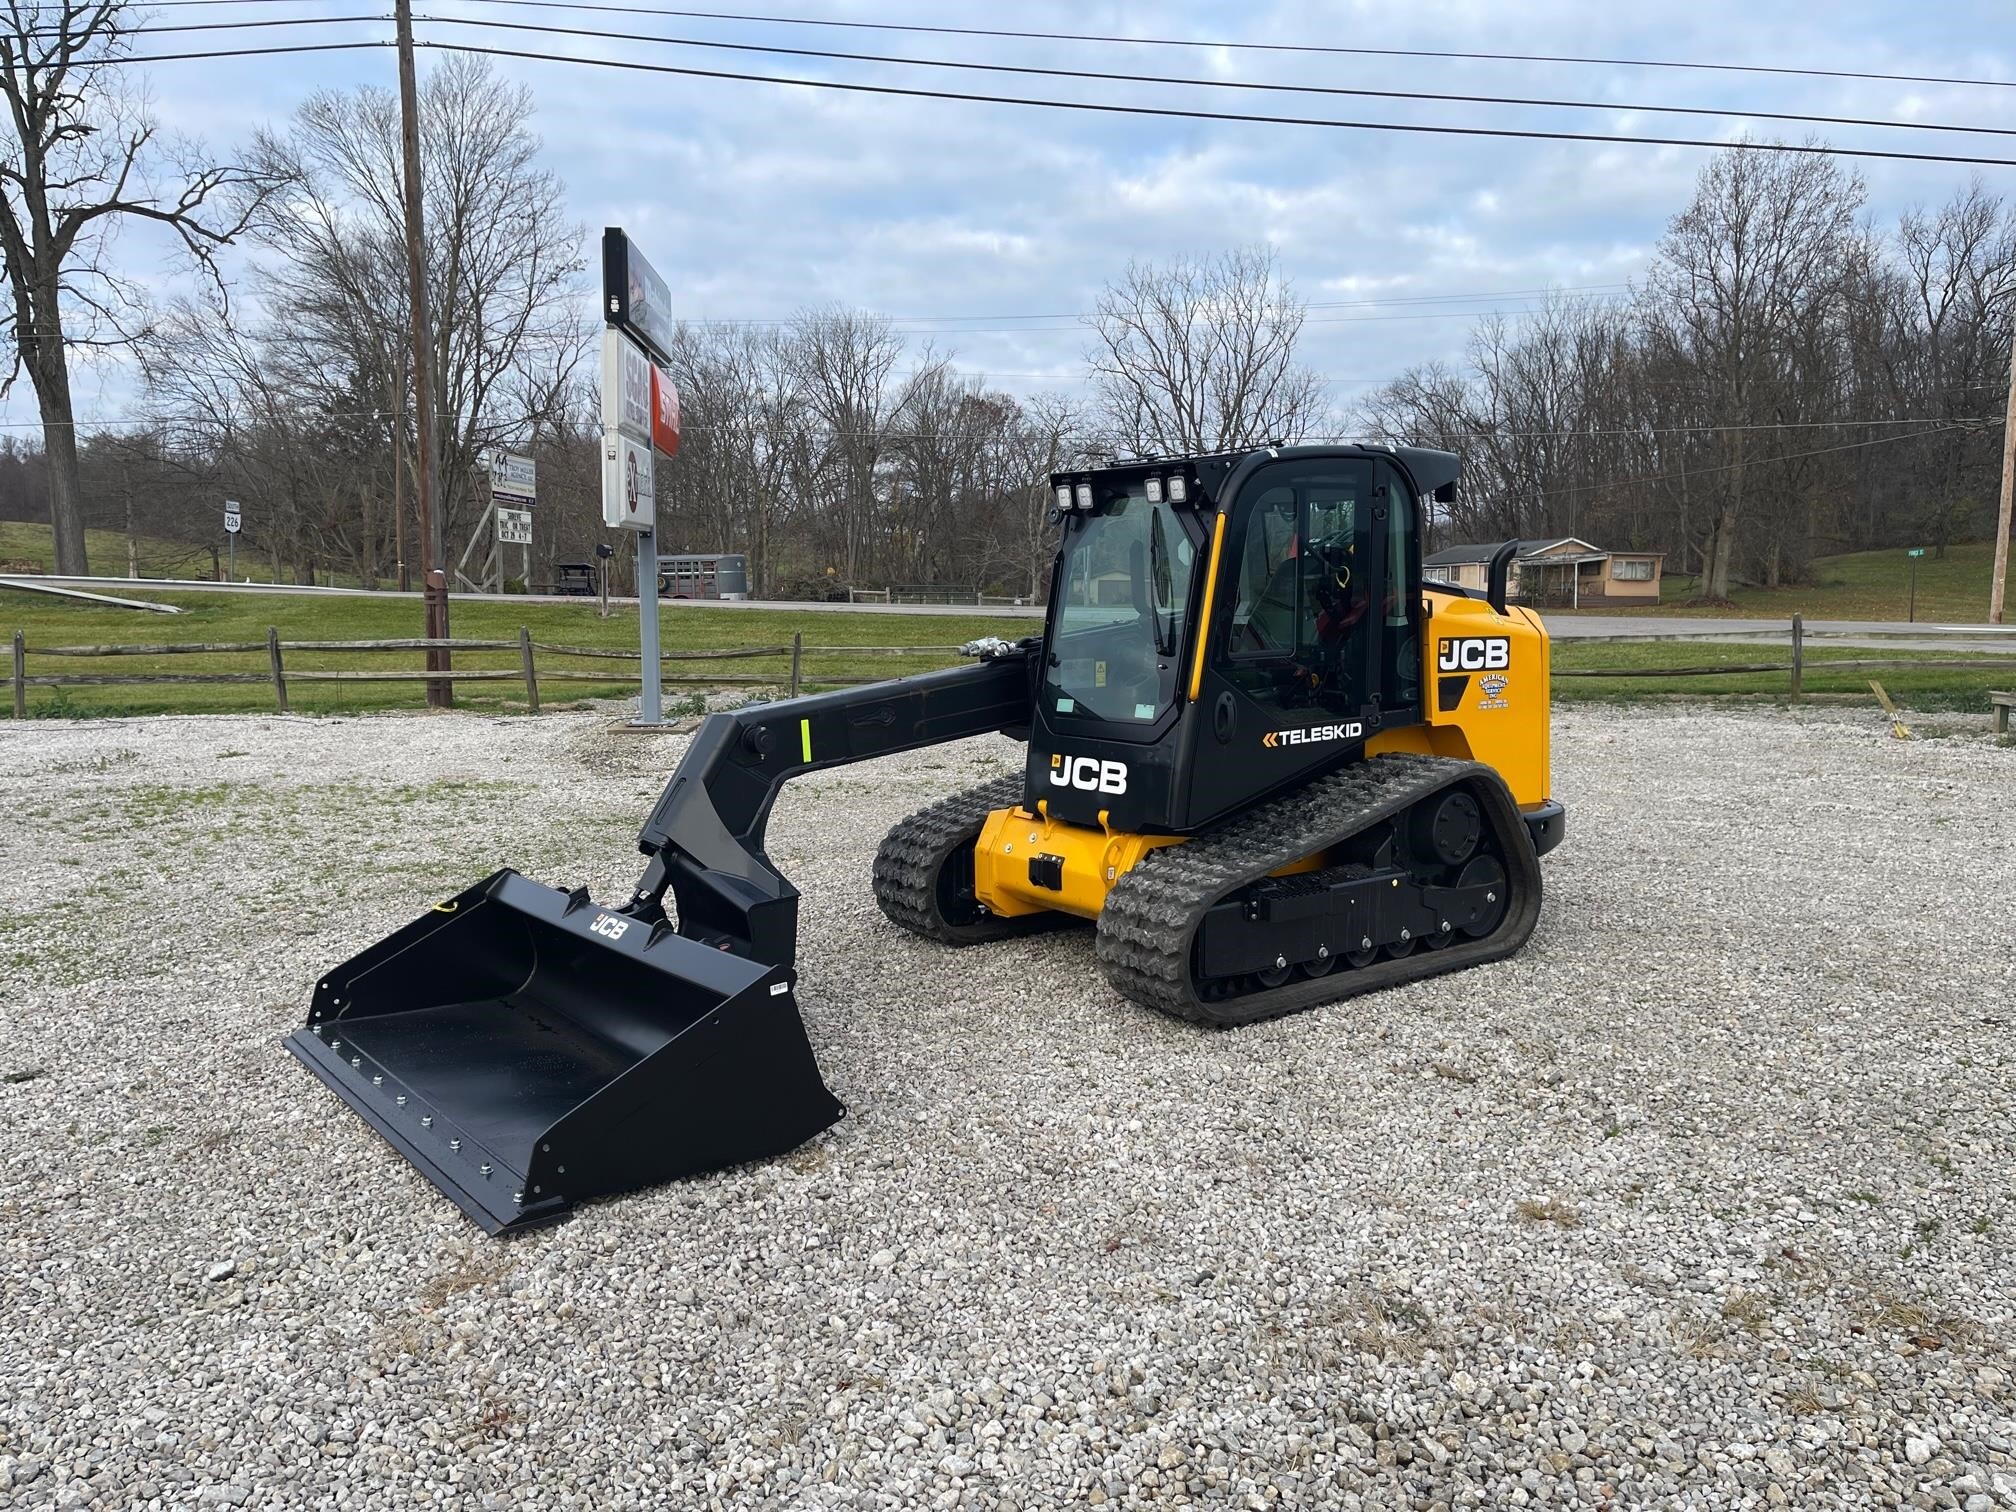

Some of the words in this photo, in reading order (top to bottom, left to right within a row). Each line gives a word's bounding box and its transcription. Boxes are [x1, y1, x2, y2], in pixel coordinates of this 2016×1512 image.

[227, 516, 239, 527] 226
[1440, 639, 1508, 670] JCB
[1479, 673, 1509, 686] AMERICAN
[1278, 722, 1362, 746] TELESKID
[1050, 755, 1128, 795] JCB
[590, 914, 629, 940] JCB
